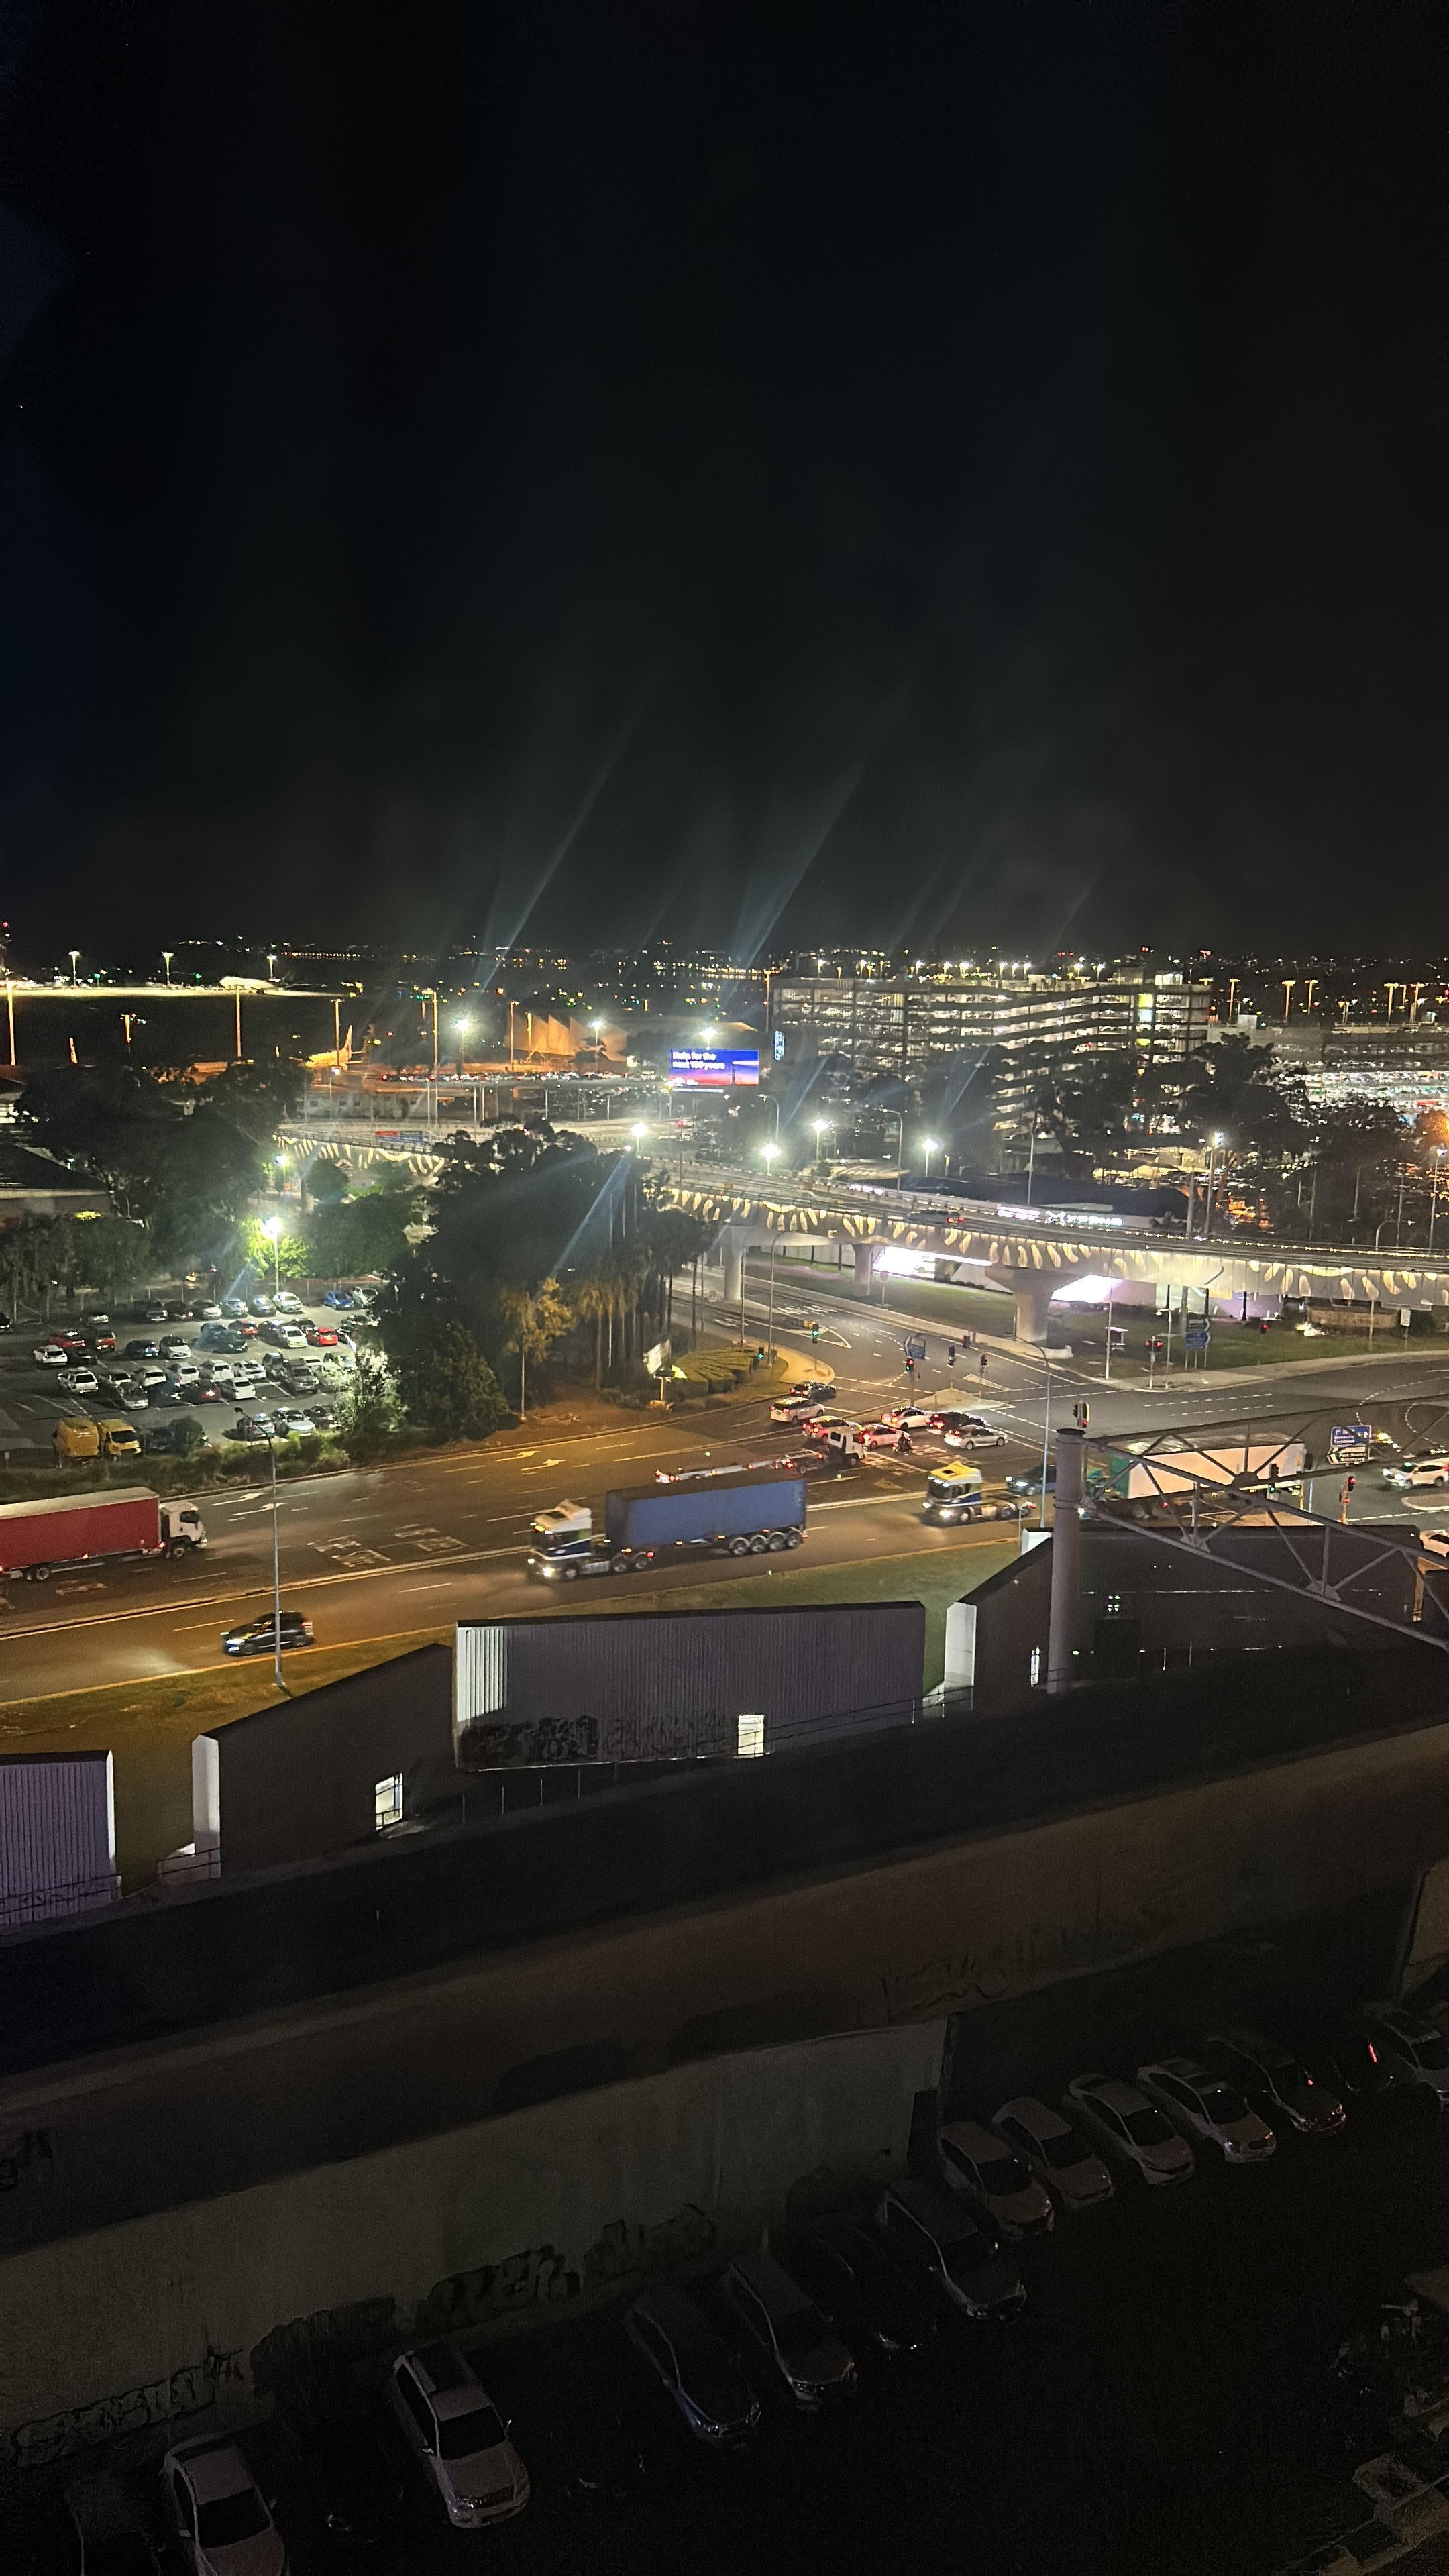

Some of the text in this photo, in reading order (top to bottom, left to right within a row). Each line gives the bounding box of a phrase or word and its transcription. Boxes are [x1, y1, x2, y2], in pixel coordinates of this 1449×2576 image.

[703, 1051, 716, 1060] the
[672, 1060, 690, 1069] next
[704, 1062, 725, 1071] years
